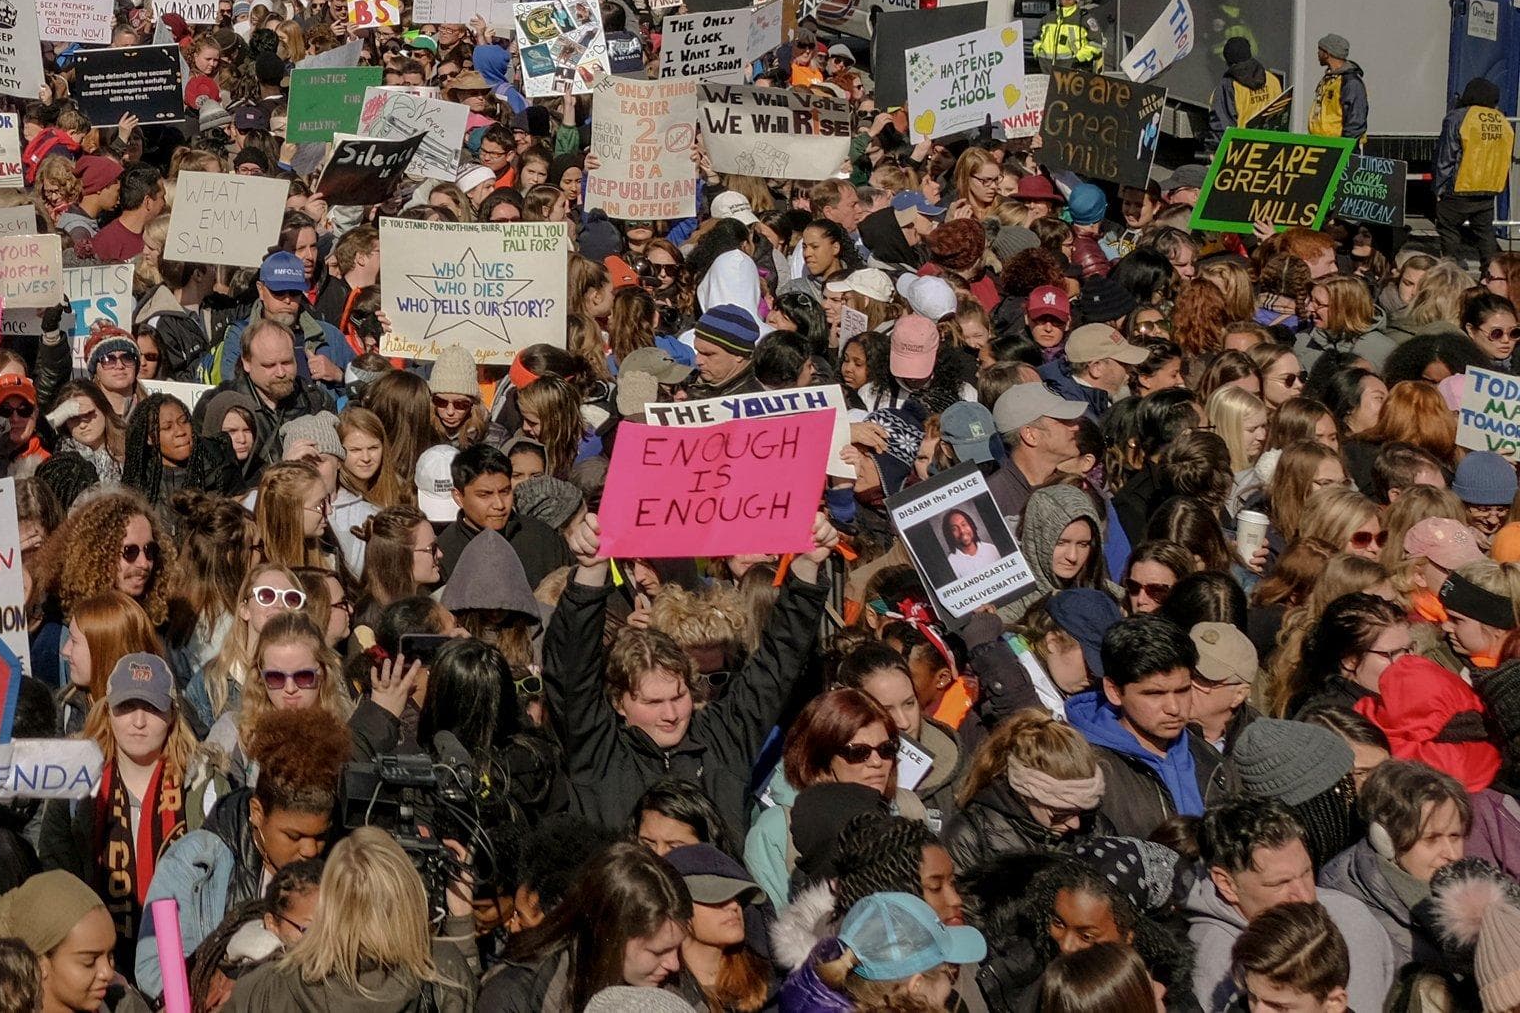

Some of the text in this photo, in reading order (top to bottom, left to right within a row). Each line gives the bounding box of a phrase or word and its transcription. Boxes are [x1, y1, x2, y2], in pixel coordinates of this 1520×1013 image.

[1472, 6, 1495, 21] United
[670, 16, 734, 33] THE ONLY
[684, 33, 722, 46] GLOCK
[958, 39, 977, 58] IT
[940, 51, 1003, 79] HAPPENED
[310, 74, 347, 84] JUSTICE
[343, 95, 363, 104] FOR
[940, 87, 996, 110] SCHOOL
[1250, 94, 1270, 104] STAFF
[1478, 112, 1502, 123] CSC
[1481, 123, 1503, 133] EVENT
[636, 118, 657, 144] 2
[1481, 132, 1504, 141] STAFF
[1225, 142, 1327, 175] WE ARE
[185, 178, 246, 204] WHAT
[587, 176, 696, 201] REPUBLICAN
[1214, 168, 1300, 196] GREAT
[199, 209, 260, 230] EMMA
[1248, 199, 1319, 226] MILLS
[503, 225, 564, 237] WHAT'LL YOU
[176, 232, 225, 255] SAID.
[503, 238, 558, 252] FALL FOR?
[432, 263, 514, 278] WHO LIVES
[434, 281, 504, 297] WHO DIES
[642, 425, 802, 469] ENOUGH
[688, 469, 733, 495] IS
[898, 477, 979, 519] DISARM the POLICE
[634, 491, 791, 529] ENOUGH
[942, 558, 1017, 599] #PHILANDOCASTILE
